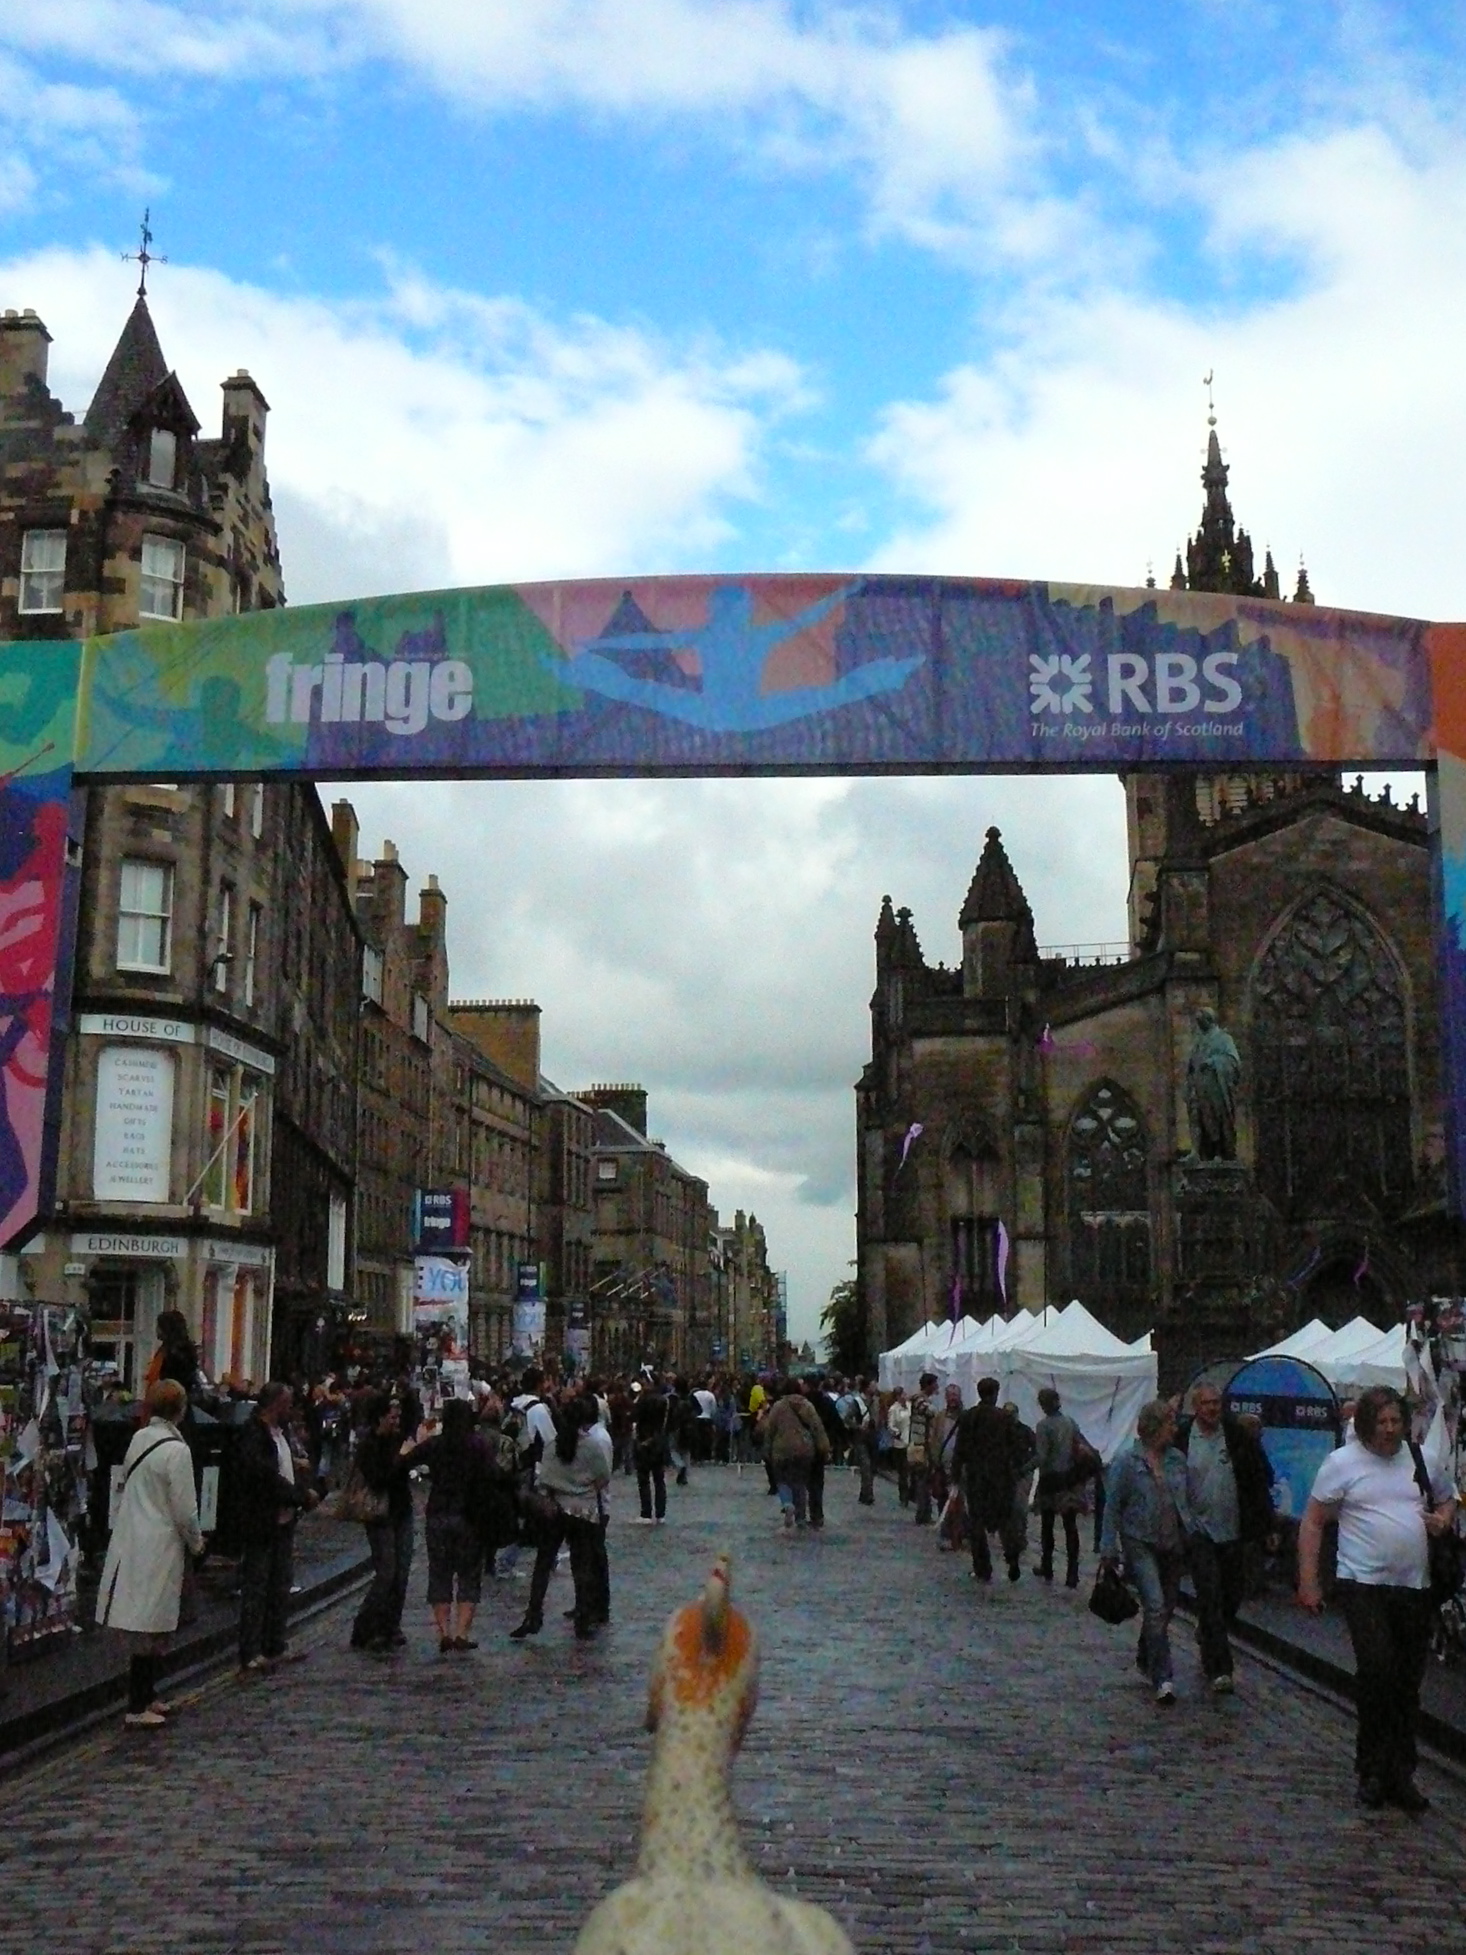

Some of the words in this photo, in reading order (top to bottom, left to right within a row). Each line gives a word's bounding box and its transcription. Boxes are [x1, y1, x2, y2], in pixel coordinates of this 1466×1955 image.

[1108, 652, 1243, 714] RBS
[265, 651, 473, 736] fringe
[1031, 722, 1059, 737] The
[1063, 722, 1107, 741] Royal
[1111, 722, 1151, 737] Bank
[1154, 721, 1172, 741] of
[1174, 720, 1244, 737] Scotland
[103, 1018, 157, 1035] HOUSE
[164, 1023, 181, 1037] OF
[118, 1087, 154, 1097] TARTAN
[109, 1102, 159, 1113] HANDMADE
[123, 1117, 147, 1126] GIFTS
[433, 1194, 452, 1206] RBS
[88, 1237, 179, 1254] EDINBURGH
[1242, 1401, 1262, 1414] RBS
[1307, 1405, 1328, 1418] RBS
